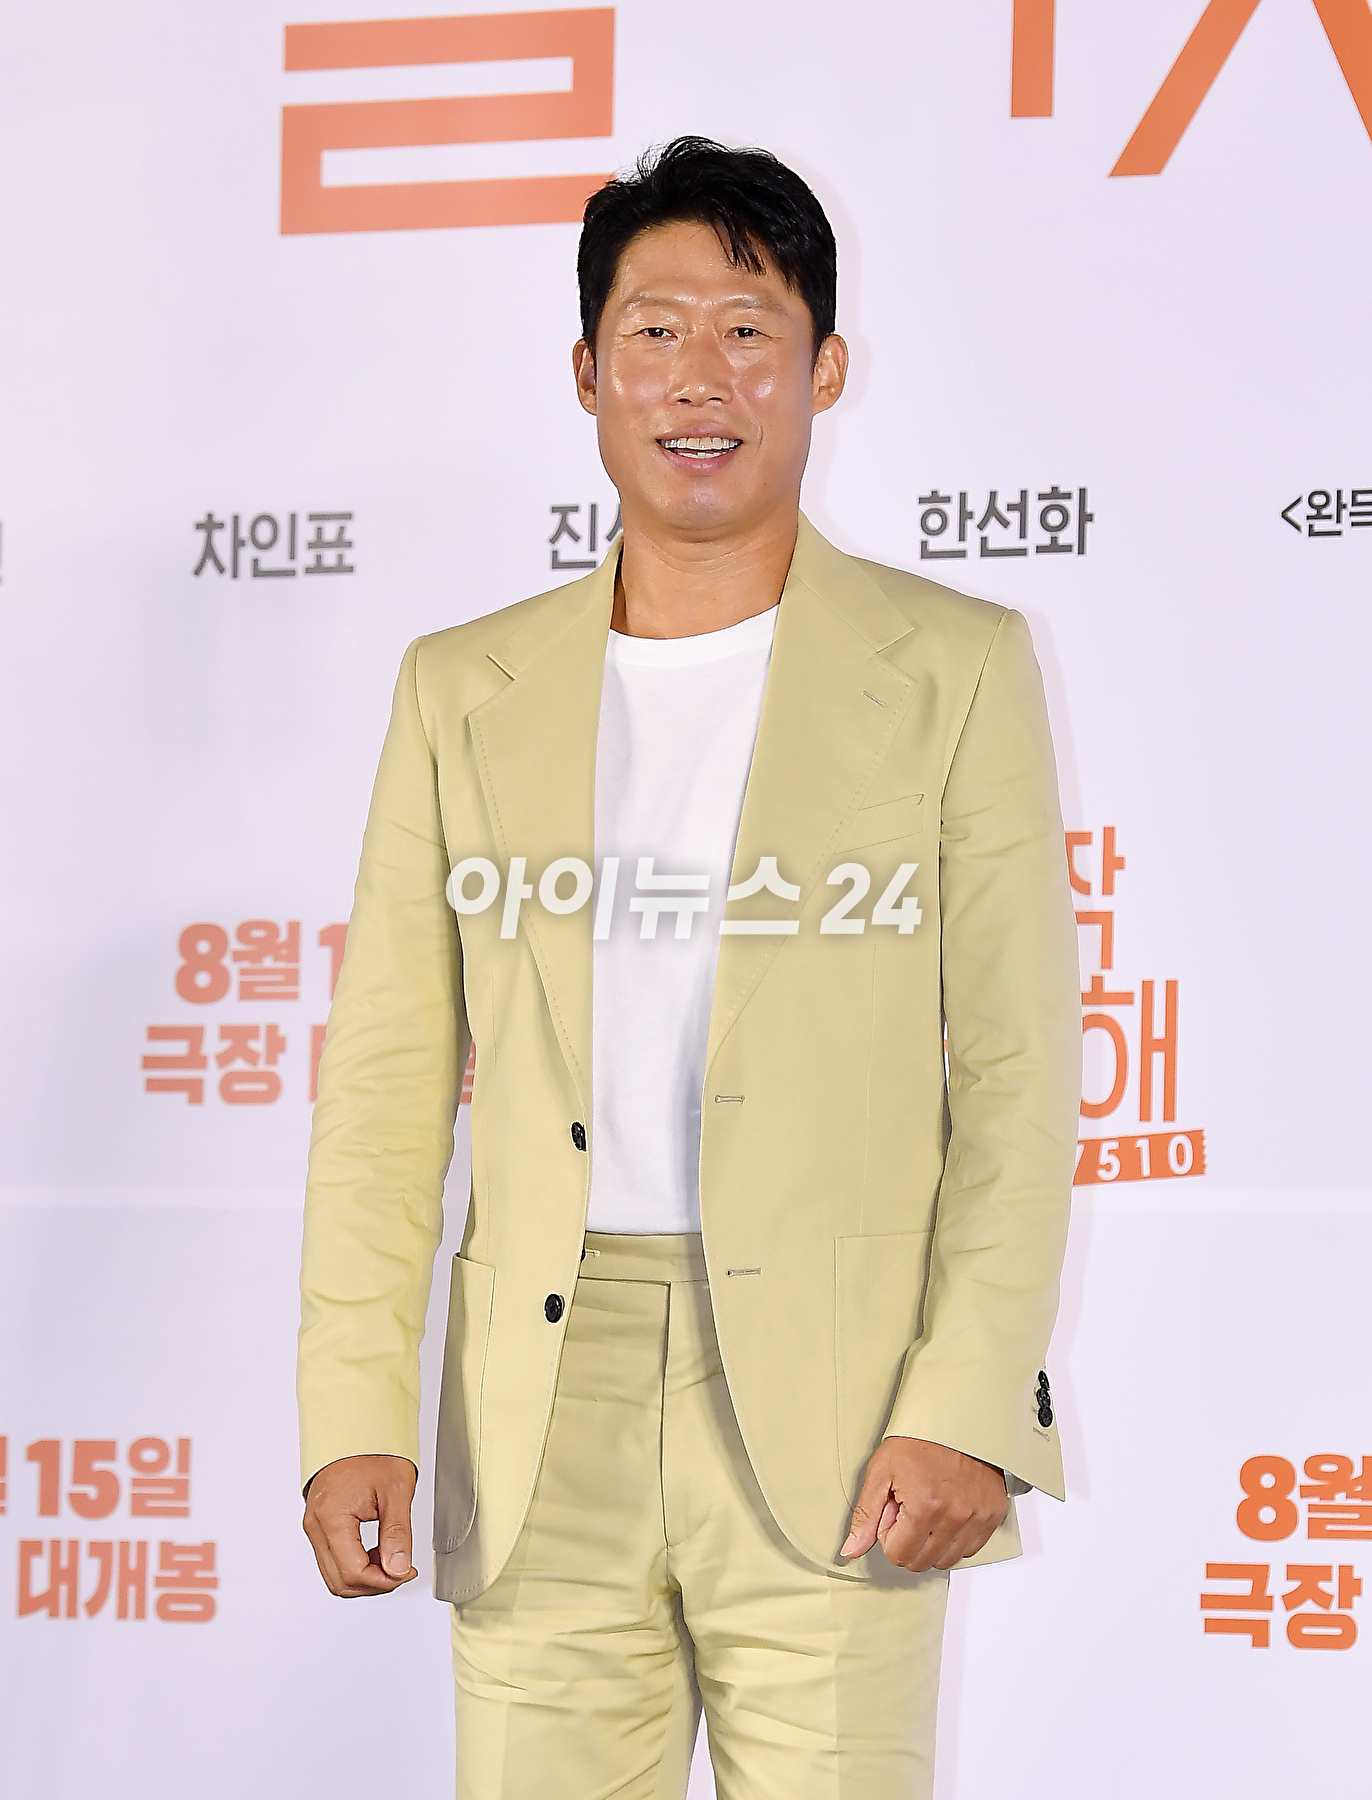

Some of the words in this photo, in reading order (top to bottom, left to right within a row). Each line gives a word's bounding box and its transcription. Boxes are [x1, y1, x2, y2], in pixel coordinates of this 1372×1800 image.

[193, 511, 355, 579] 차인표
[918, 486, 1094, 559] 한선화
[174, 920, 300, 1004] 8월
[141, 1024, 287, 1104] 극장
[26, 1437, 191, 1520] 15일
[1236, 1454, 1372, 1541] 8월
[17, 1540, 219, 1622] 대개봉
[1200, 1562, 1362, 1650] 극장
